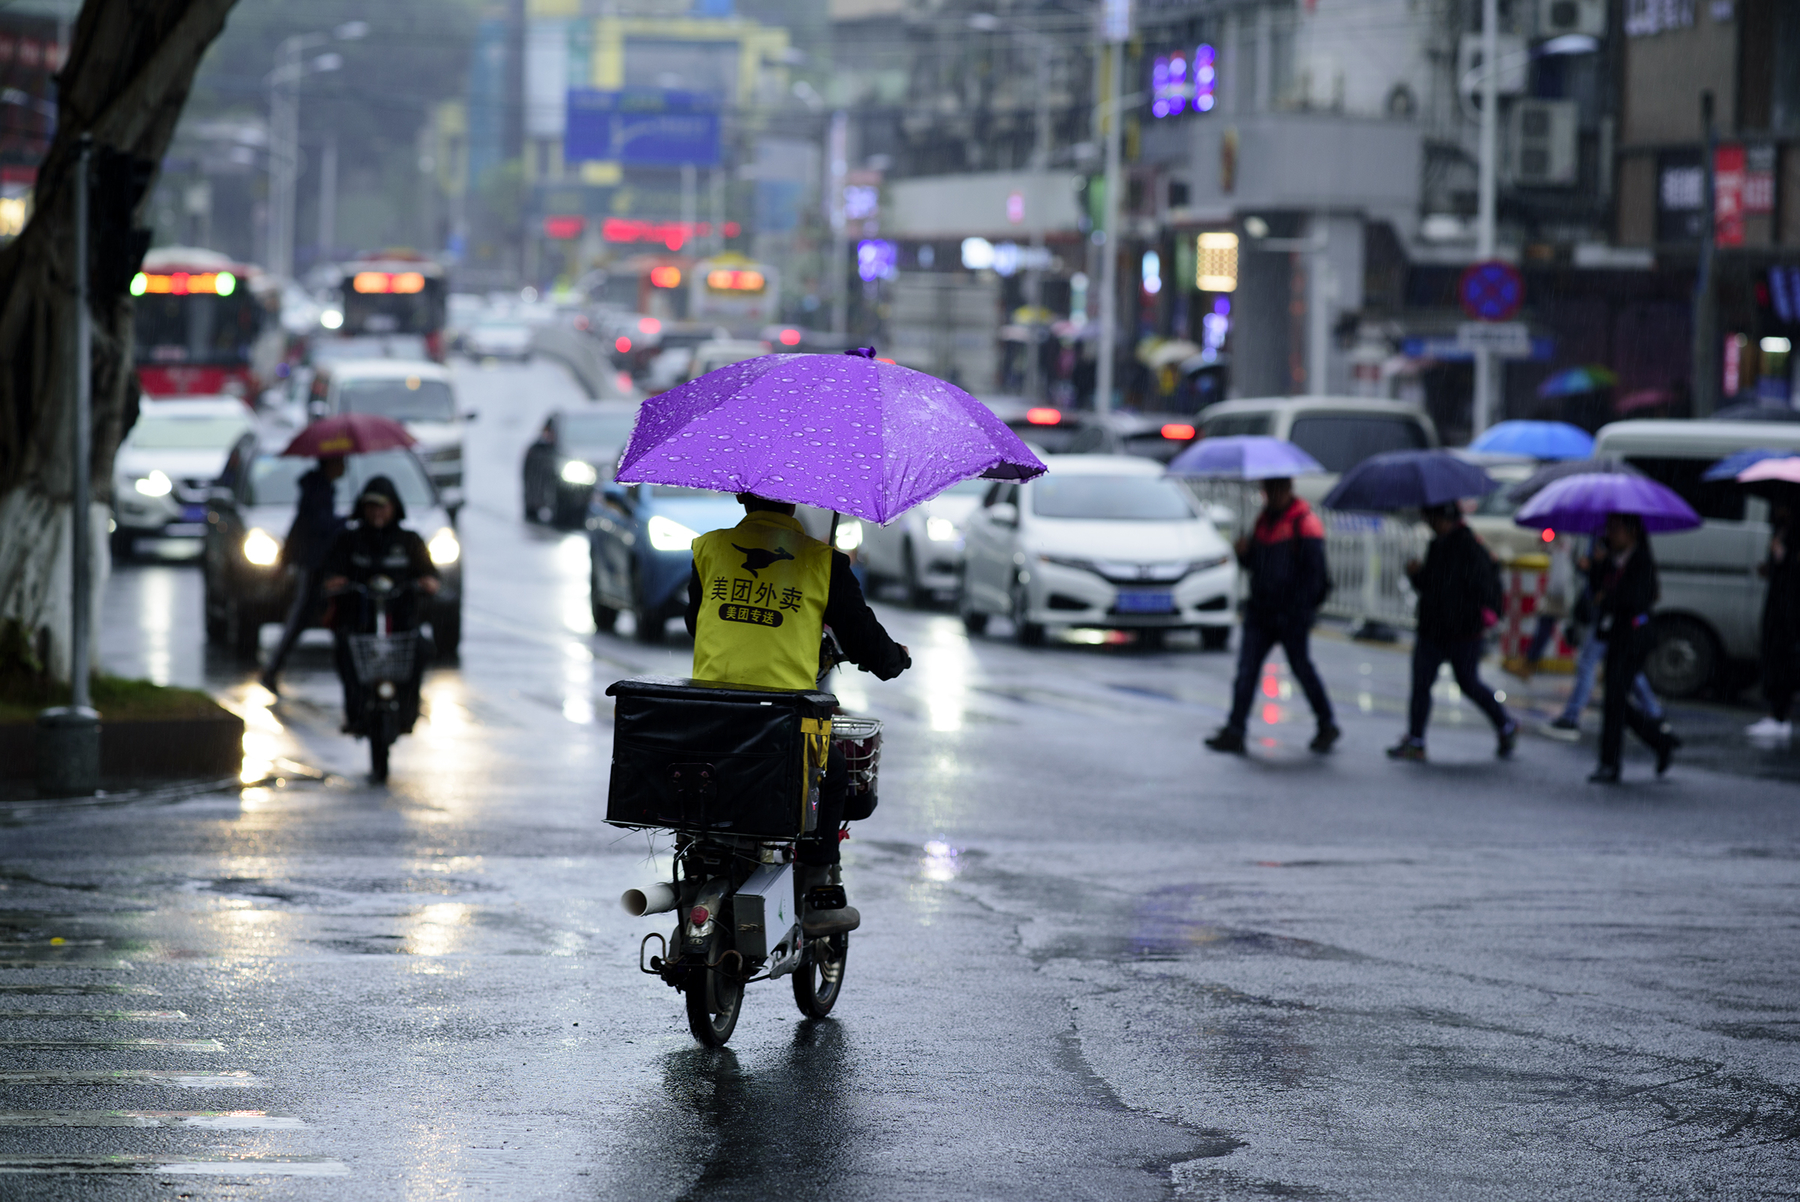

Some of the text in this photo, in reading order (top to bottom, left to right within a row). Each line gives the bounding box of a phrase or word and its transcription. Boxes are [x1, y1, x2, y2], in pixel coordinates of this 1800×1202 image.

[711, 576, 803, 613] 美团外卖
[725, 605, 775, 625] 美团专送
